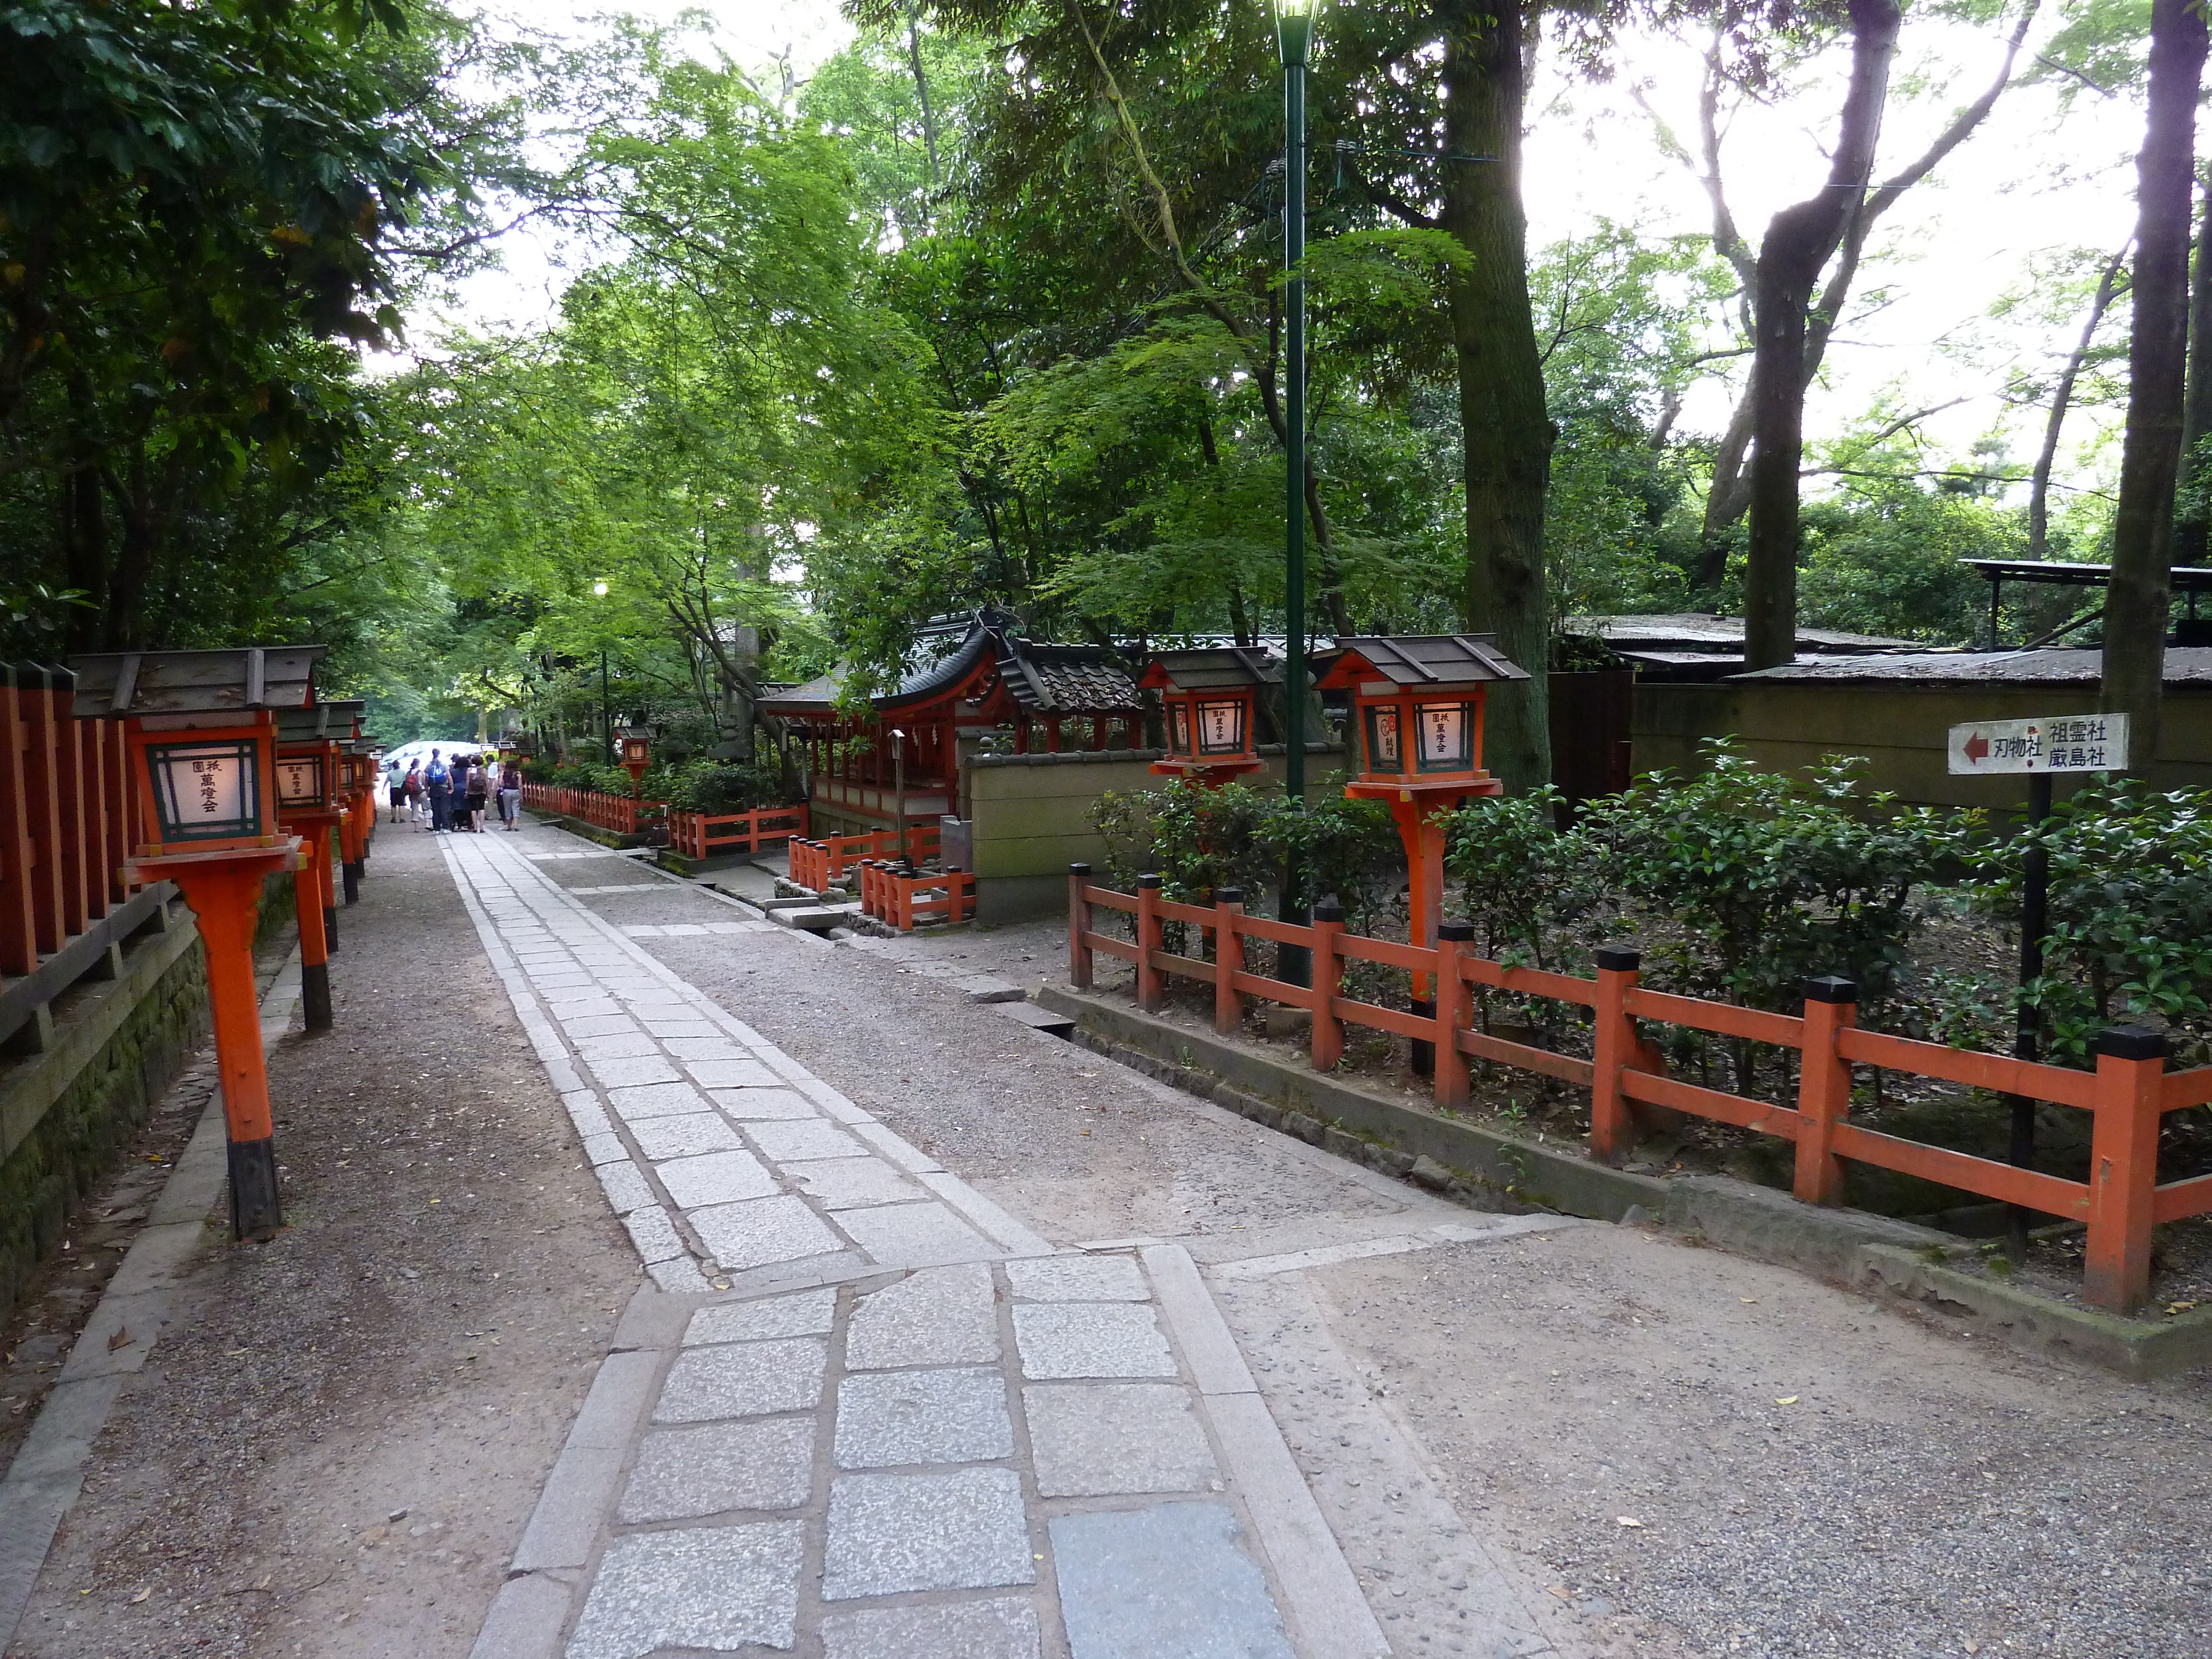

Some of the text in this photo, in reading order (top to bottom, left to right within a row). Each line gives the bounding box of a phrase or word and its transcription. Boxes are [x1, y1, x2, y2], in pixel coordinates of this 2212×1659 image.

[2048, 720, 2107, 743] 祖霊社
[1994, 735, 2043, 758] 刃物社
[2048, 746, 2106, 768] 厳島社
[200, 773, 218, 813] 萬燈会
